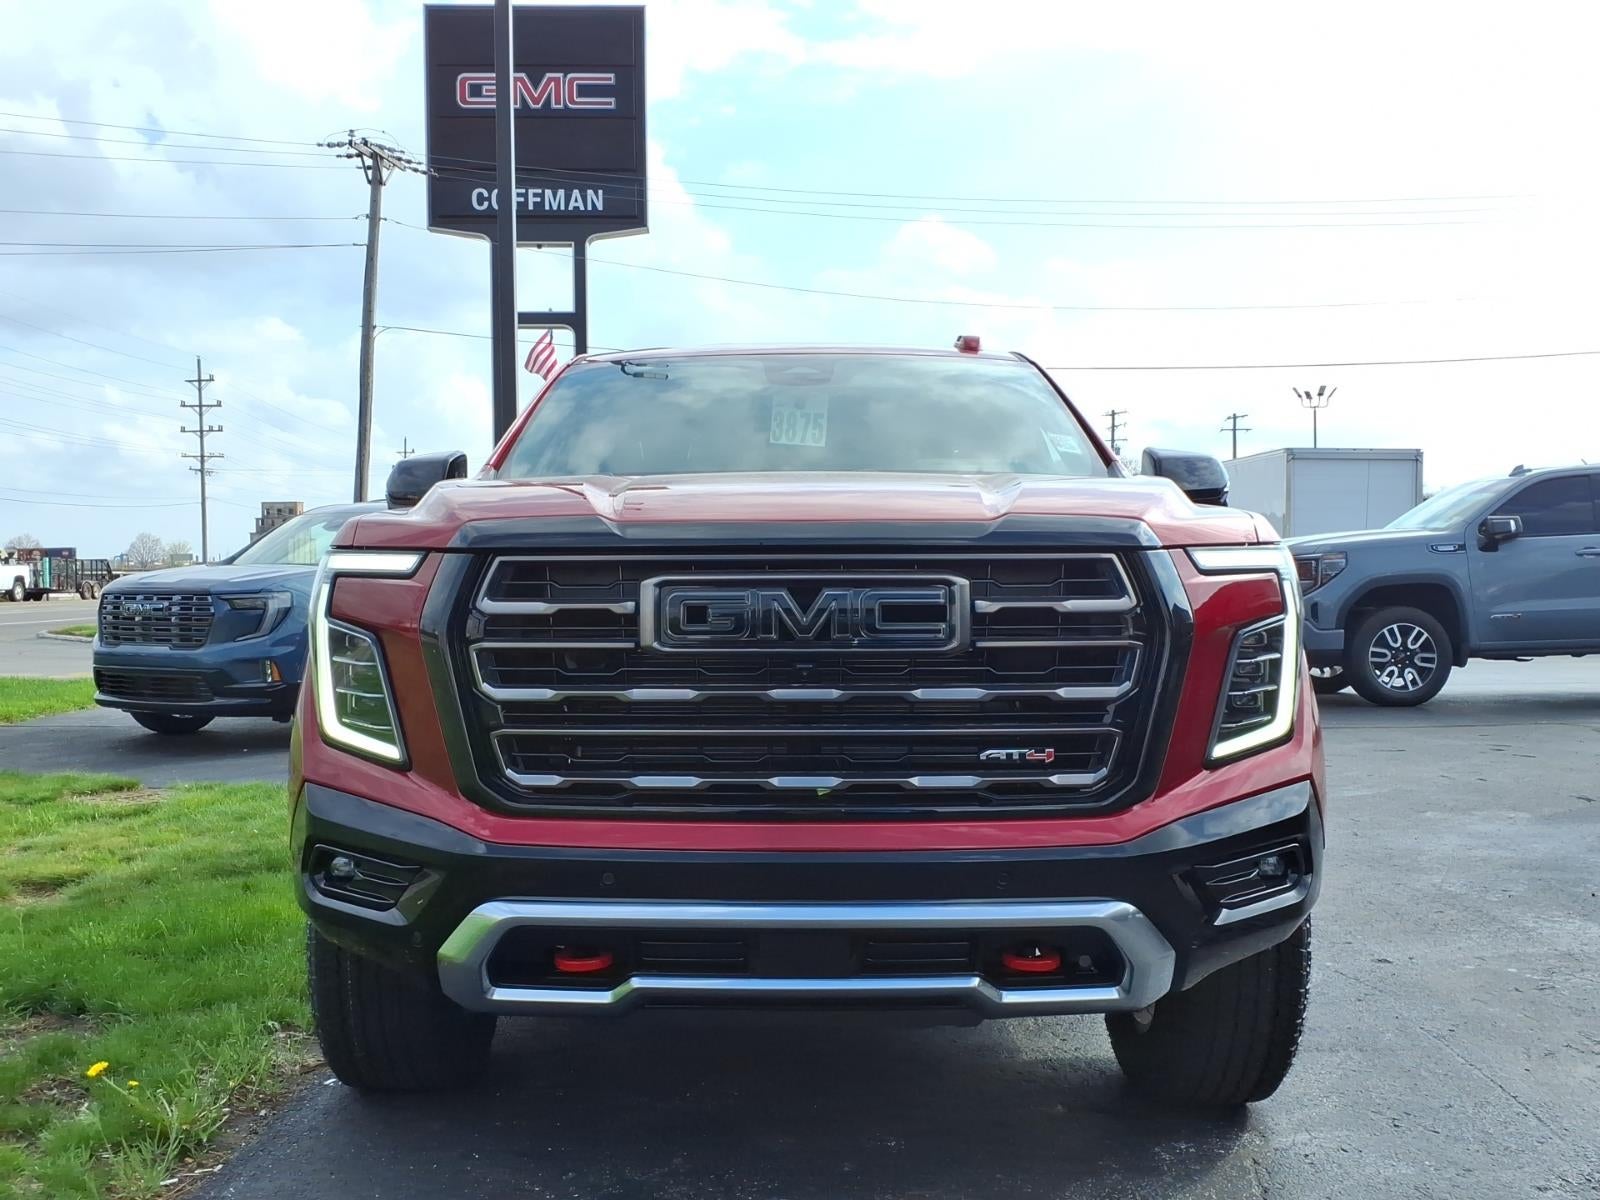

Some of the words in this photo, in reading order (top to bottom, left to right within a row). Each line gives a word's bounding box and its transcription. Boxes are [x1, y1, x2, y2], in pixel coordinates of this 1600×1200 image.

[456, 72, 616, 109] GMC
[771, 410, 825, 444] 3875
[124, 603, 163, 616] GMC
[663, 588, 948, 640] GMC
[979, 748, 1054, 763] AT4
